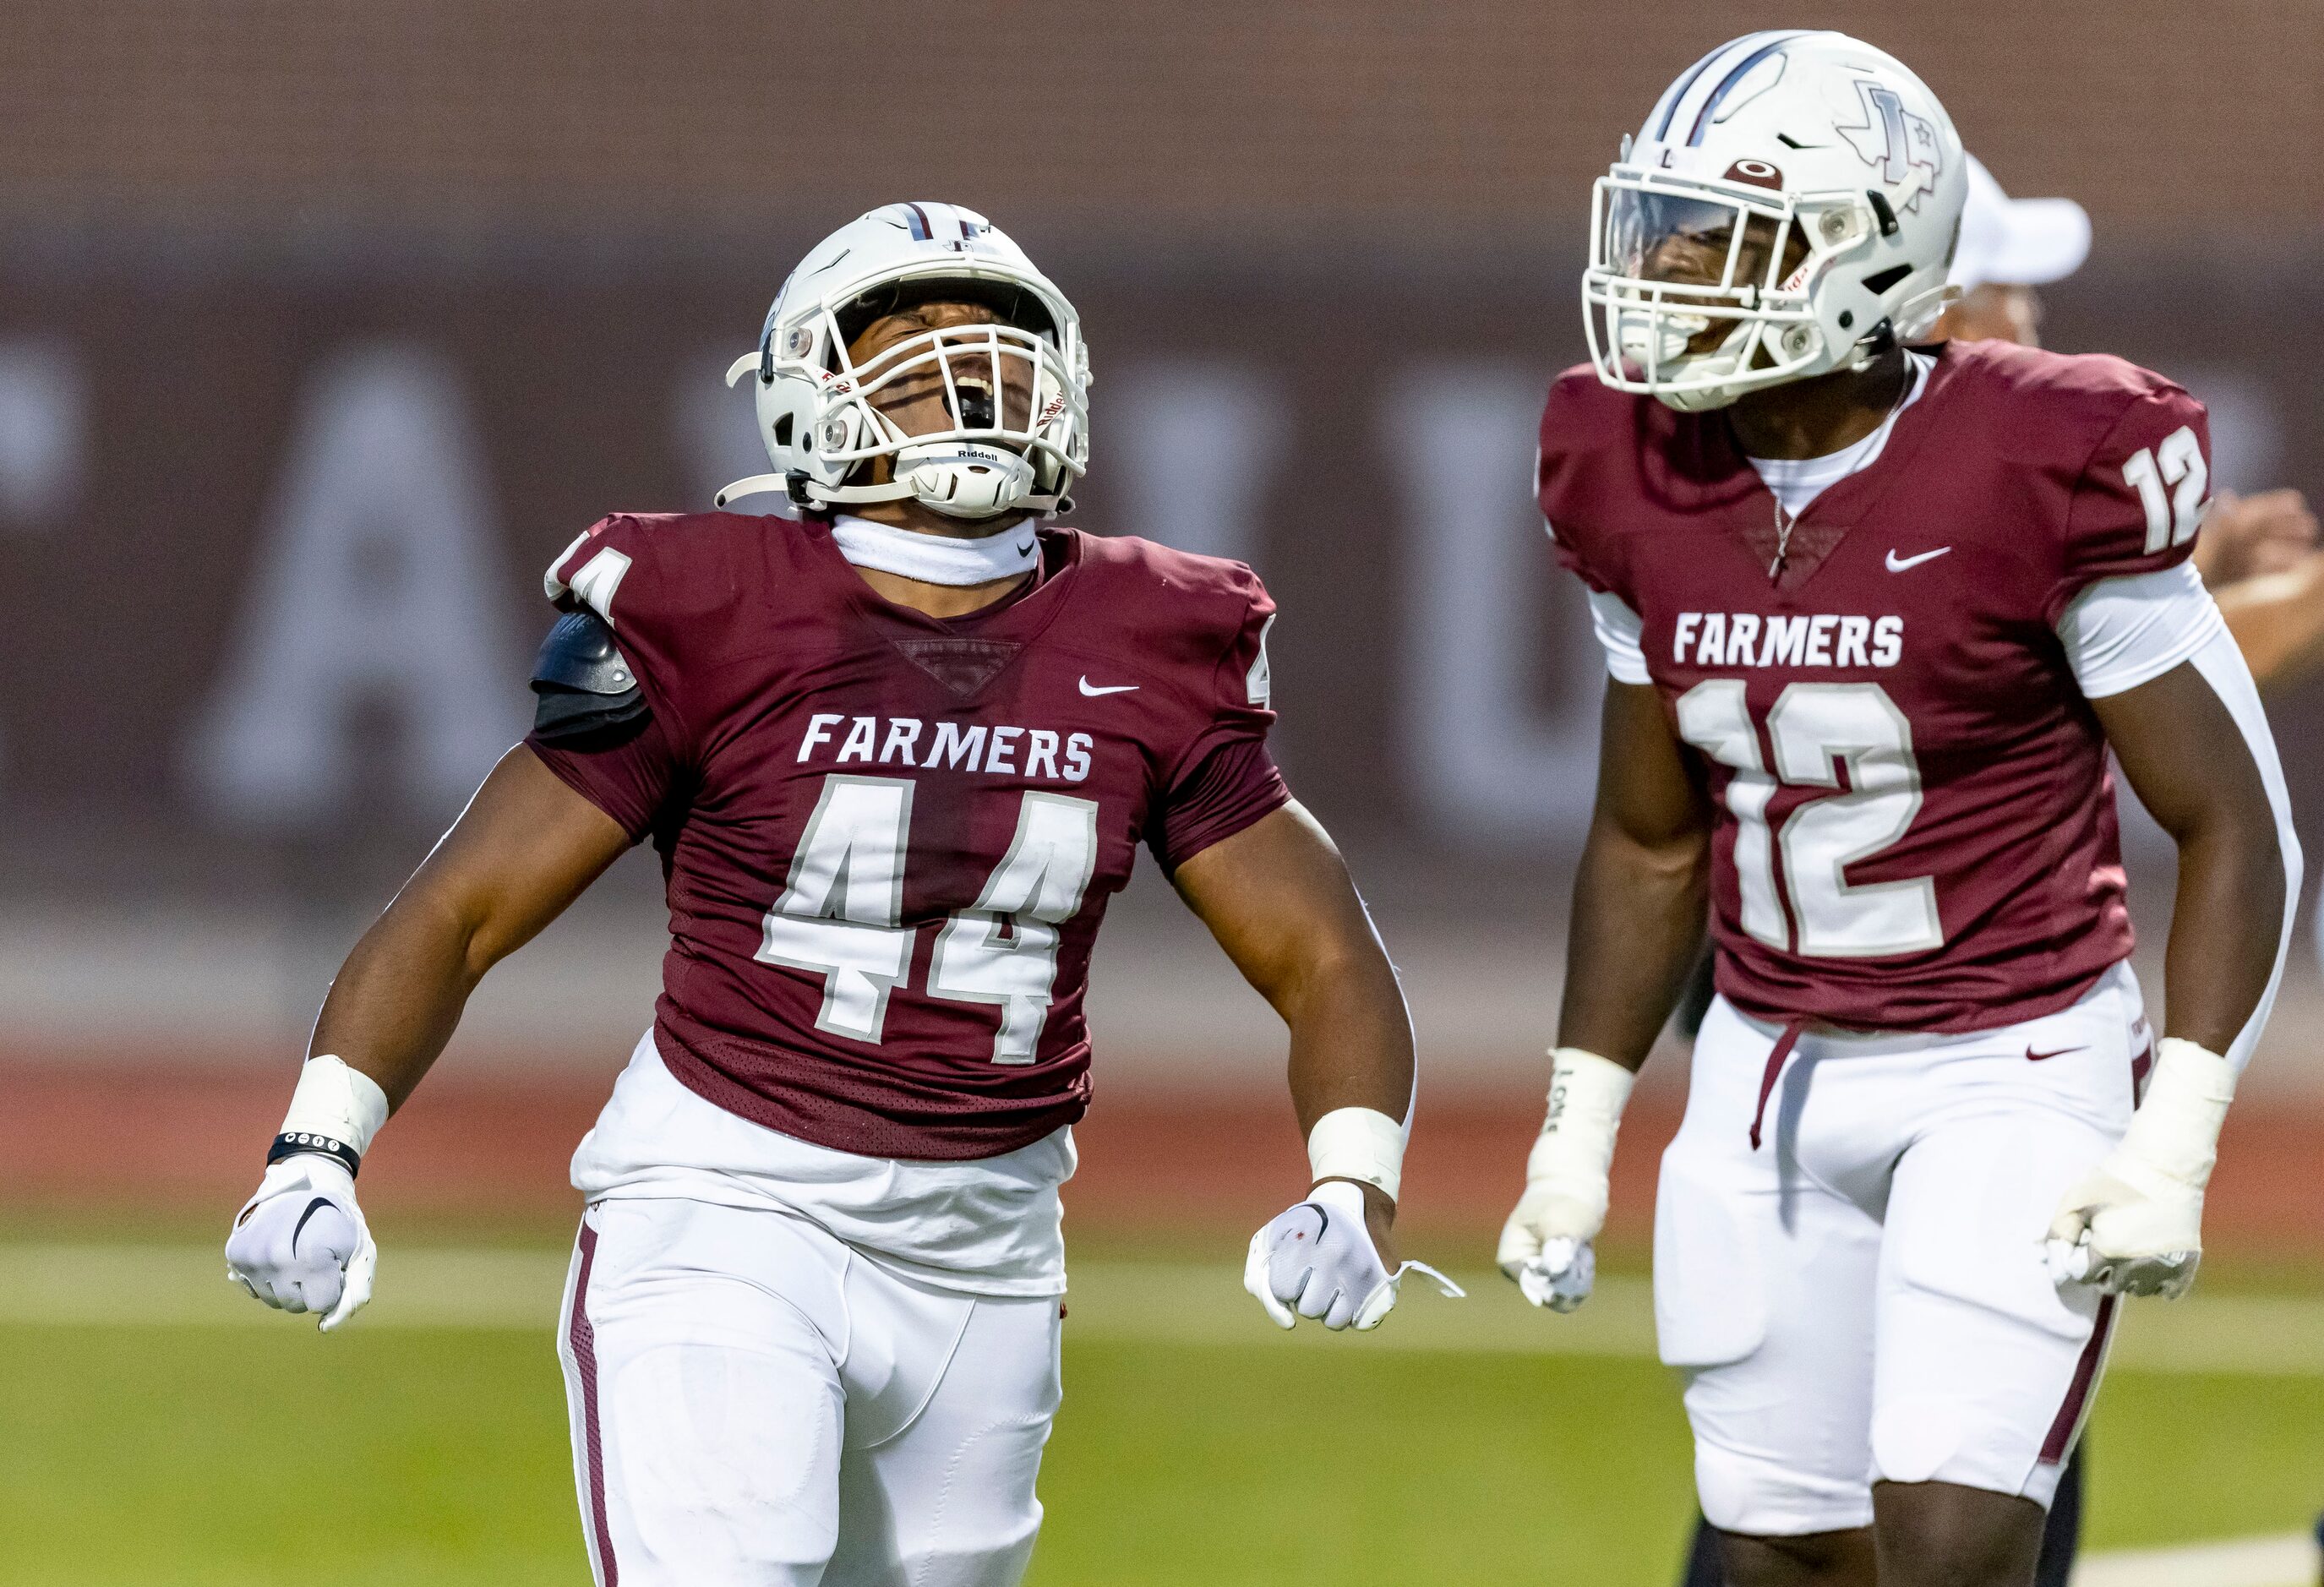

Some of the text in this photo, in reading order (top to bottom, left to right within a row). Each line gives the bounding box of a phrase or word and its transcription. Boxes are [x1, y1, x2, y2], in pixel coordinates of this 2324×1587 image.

[957, 450, 998, 462] Riddell
[2122, 425, 2215, 555] 12
[1674, 613, 1904, 668] FARMERS
[797, 714, 1094, 782] FARMERS
[1677, 679, 1945, 957] 12
[752, 772, 1099, 1065] 44
